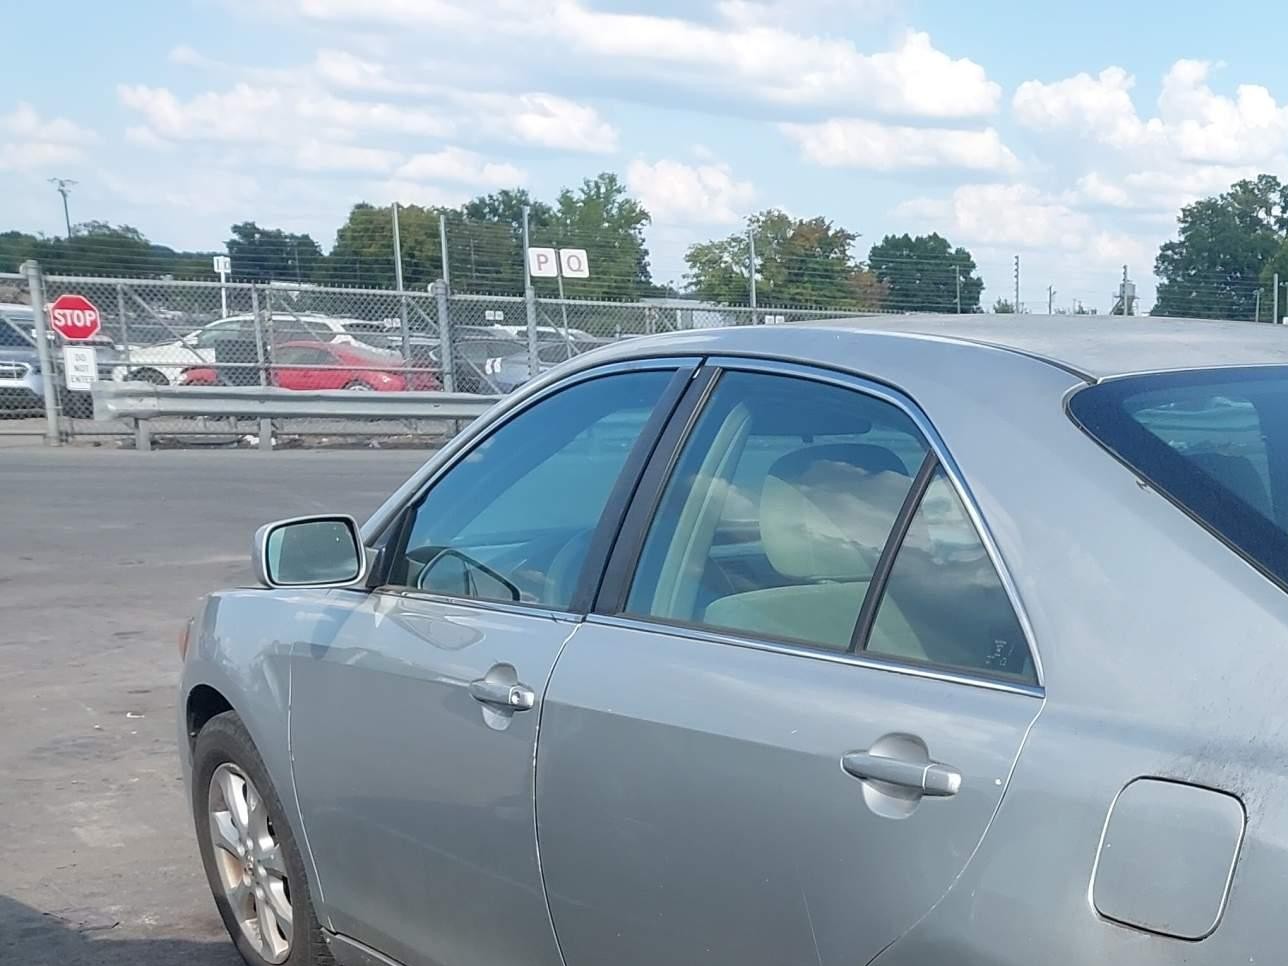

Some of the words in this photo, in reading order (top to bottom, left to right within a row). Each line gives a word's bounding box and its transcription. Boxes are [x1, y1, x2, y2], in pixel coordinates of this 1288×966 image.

[536, 254, 548, 271] P
[567, 254, 584, 272] Q
[54, 309, 96, 327] STOP
